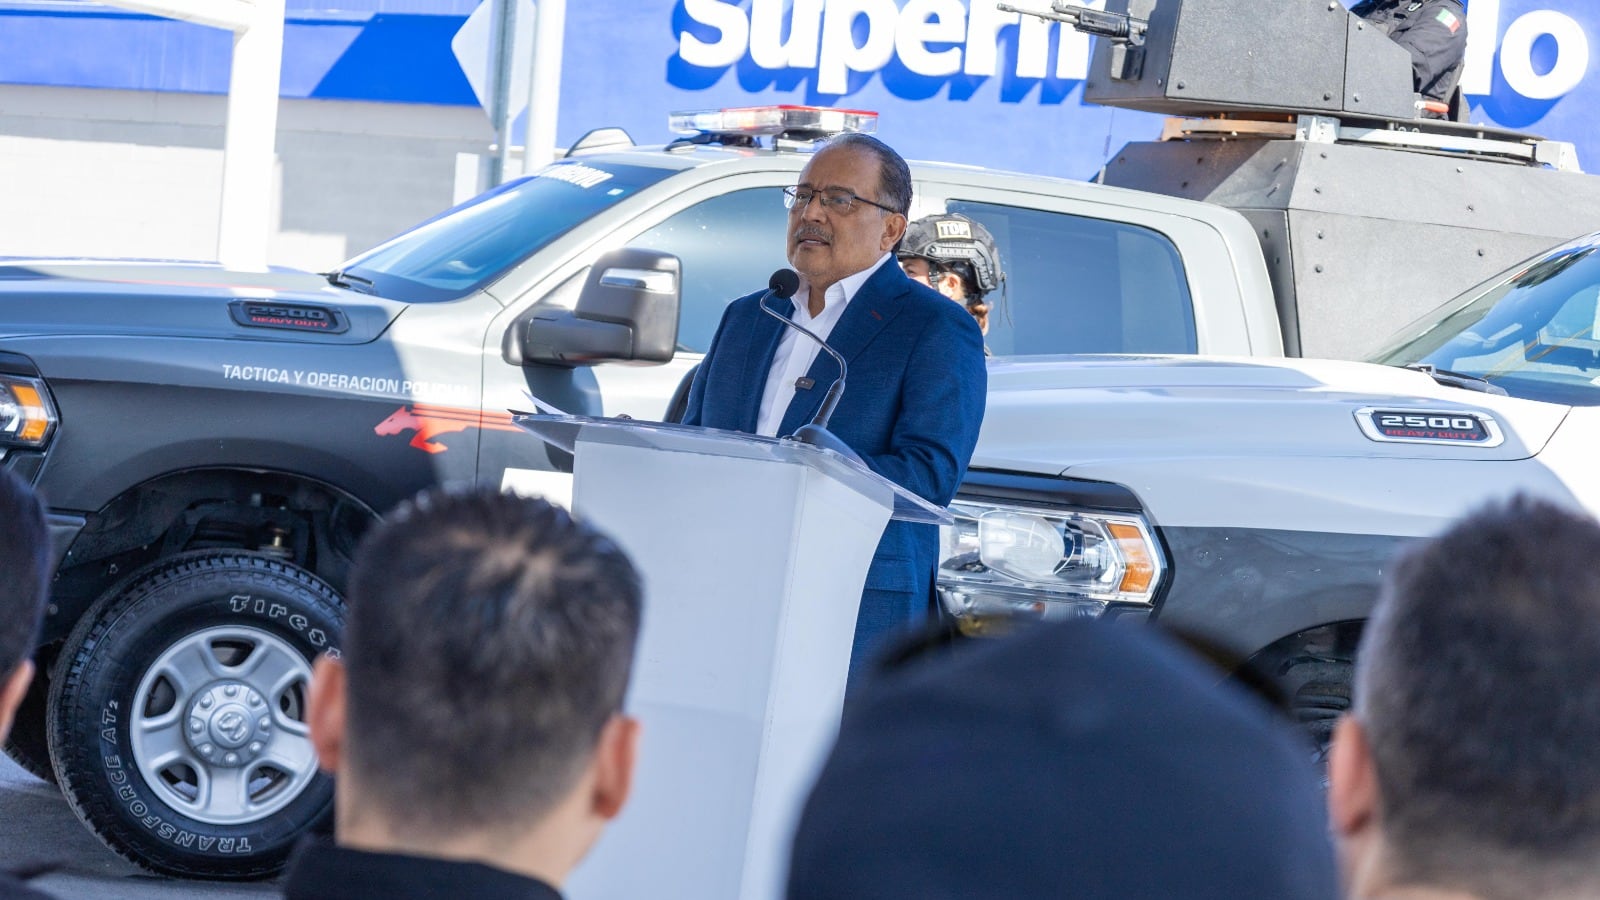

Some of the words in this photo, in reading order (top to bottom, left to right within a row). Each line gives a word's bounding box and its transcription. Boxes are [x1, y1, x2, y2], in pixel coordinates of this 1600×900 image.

[940, 222, 969, 236] TOP
[248, 306, 325, 320] 2500
[252, 316, 293, 325] HEAVY
[294, 319, 329, 328] DUTY
[222, 364, 289, 384] TACTICA
[293, 371, 304, 385] Y
[306, 372, 399, 393] OPERACION
[1381, 415, 1474, 430] 2500
[1385, 428, 1436, 437] HEAVY
[1437, 431, 1479, 440] DUTY
[104, 754, 252, 853] TRANSFORCE
